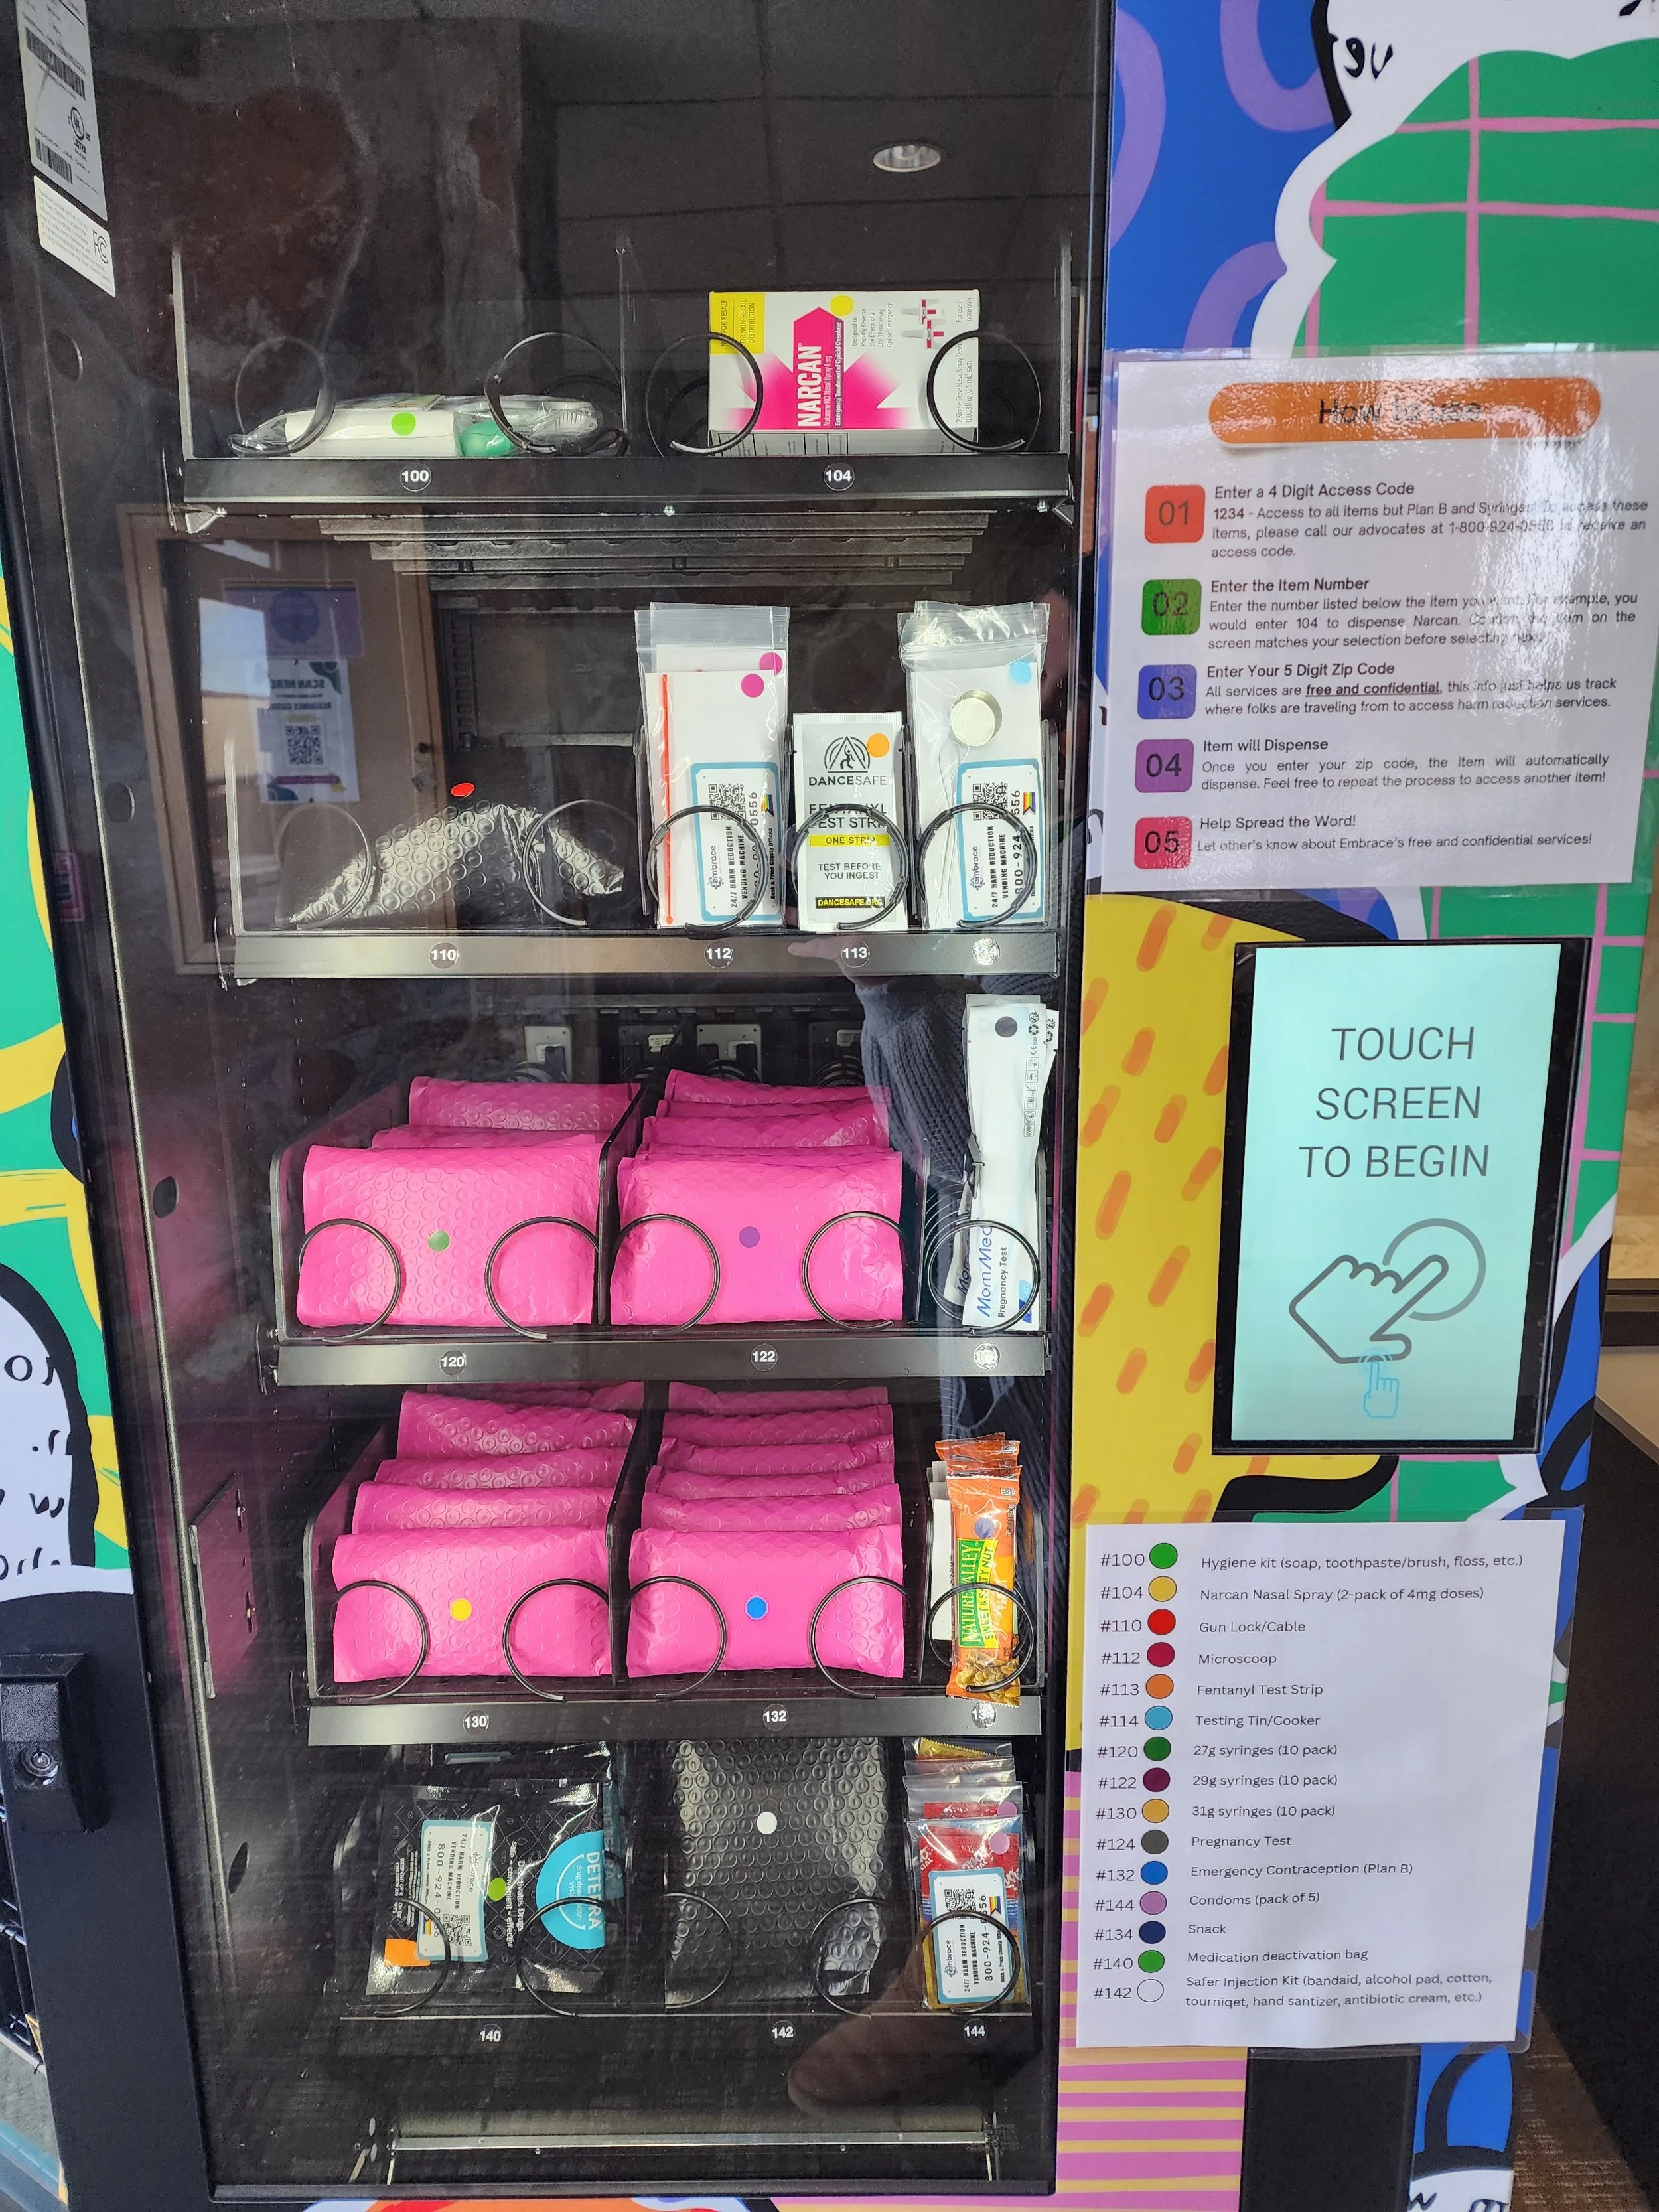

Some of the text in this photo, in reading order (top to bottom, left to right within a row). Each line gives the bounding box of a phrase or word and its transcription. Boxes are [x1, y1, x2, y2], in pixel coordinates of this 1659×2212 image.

[965, 297, 974, 307] only
[797, 345, 822, 427] NARCAN
[401, 469, 429, 482] 100
[826, 469, 852, 482] 104
[1215, 482, 1414, 500] Enter a 4 Digit Access Code
[1159, 501, 1188, 525] 01
[1211, 577, 1370, 593] Enter the Item Number
[1153, 591, 1188, 617] 02
[1207, 662, 1395, 679] Enter Your 5 Digit Zip Code
[1149, 676, 1184, 701] 03
[1204, 739, 1328, 753] Item will Dispense
[1146, 753, 1182, 777] 04
[808, 776, 887, 786] DANCESAFE
[808, 817, 845, 828] EST
[1200, 815, 1356, 832] Help Spread the Word!
[987, 826, 996, 865] REDUCTION
[1145, 830, 1180, 855] 05
[998, 834, 1009, 899] VENDING MACHINE
[431, 949, 456, 962] 110
[706, 948, 732, 959] 112
[843, 947, 868, 959] 113
[1331, 1026, 1475, 1061] TOUCH
[1316, 1086, 1480, 1120] SCREEN
[1299, 1145, 1489, 1178] TO BEGIN
[997, 1269, 1008, 1318] Pregnancy
[441, 1356, 465, 1368] 120
[753, 1351, 776, 1363] 122
[981, 1546, 993, 1568] NUT
[1100, 1554, 1522, 1571] #100 Hygiene kit (soap, toothpaste/brush, floss, etc.)
[961, 1544, 981, 1643] NATURE ALLEY
[1100, 1587, 1483, 1603] #104 Narcan Nasal Spray (2-pack of 4mg doses)
[1100, 1619, 1305, 1633] #110 Gun Lock/Cable
[1101, 1652, 1276, 1666] #112 Microscoop
[1100, 1684, 1323, 1698] #113 Fentanyl Test Strip
[464, 1716, 487, 1728] 130
[764, 1710, 787, 1722] 132
[1099, 1715, 1321, 1728] #114 Testing Tin/Cooker
[1097, 1745, 1337, 1758] #120 27g syringes (10 pack)
[1096, 1836, 1292, 1850] #124 Pregnancy Test
[1096, 1864, 1413, 1881] #132 Emergency Contraception (Plan B)
[1094, 1892, 1319, 1911] #144 Condoms (pack of 5)
[516, 1908, 525, 1931] Drugs
[1094, 1924, 1226, 1940] #134 Snack
[1092, 1949, 1368, 1970] #140 Medication deactivation bag
[1186, 1974, 1492, 1989] Safer Injection Kit (bandaid, alcohol pad, cotton,
[1094, 1988, 1131, 1999] #142
[1185, 1992, 1482, 2009] tourniqet, hand santizer, antibiotic cream, etc.)
[480, 2031, 501, 2042] 140
[772, 2027, 794, 2039] 142
[964, 2026, 986, 2037] 144
